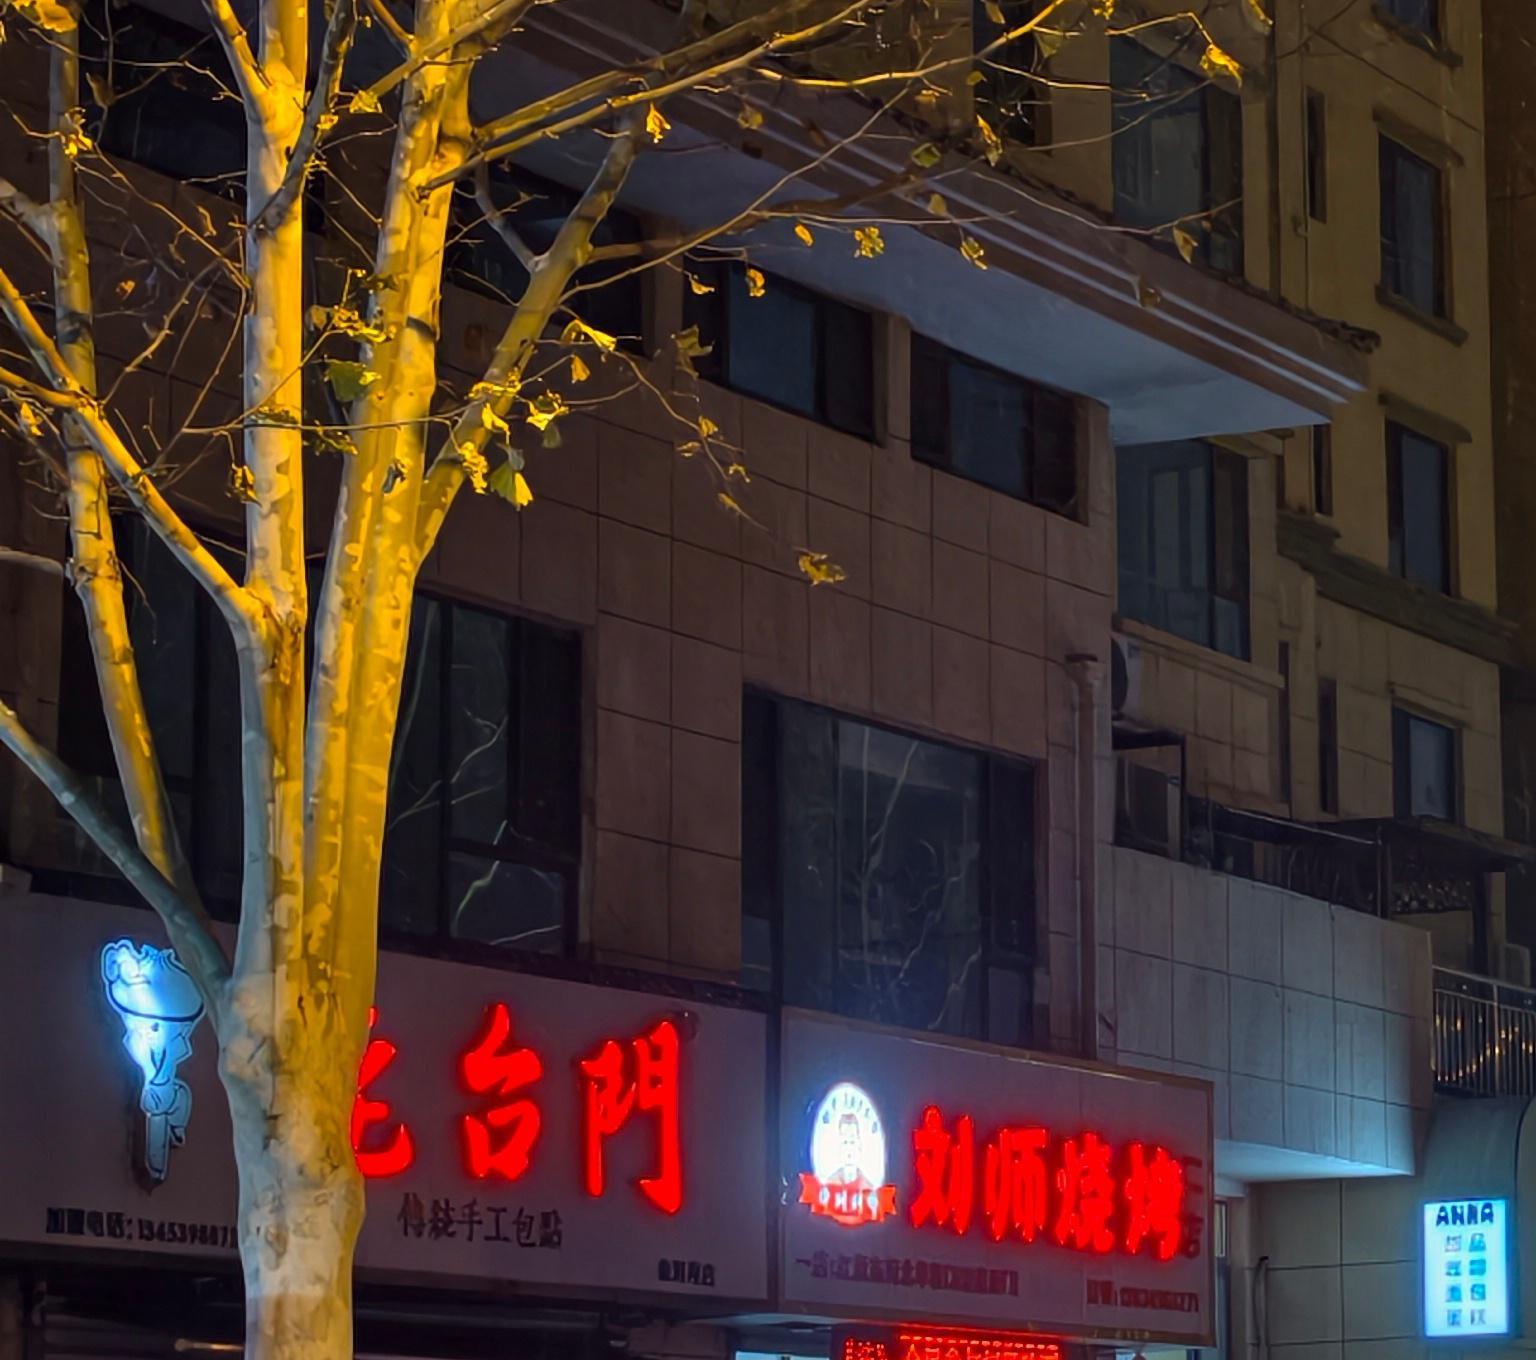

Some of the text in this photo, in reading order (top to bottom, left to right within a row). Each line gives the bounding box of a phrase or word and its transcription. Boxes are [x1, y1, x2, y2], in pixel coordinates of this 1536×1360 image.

[911, 1103, 1184, 1261] 刘师烧烤
[1436, 1202, 1494, 1227] ANNA
